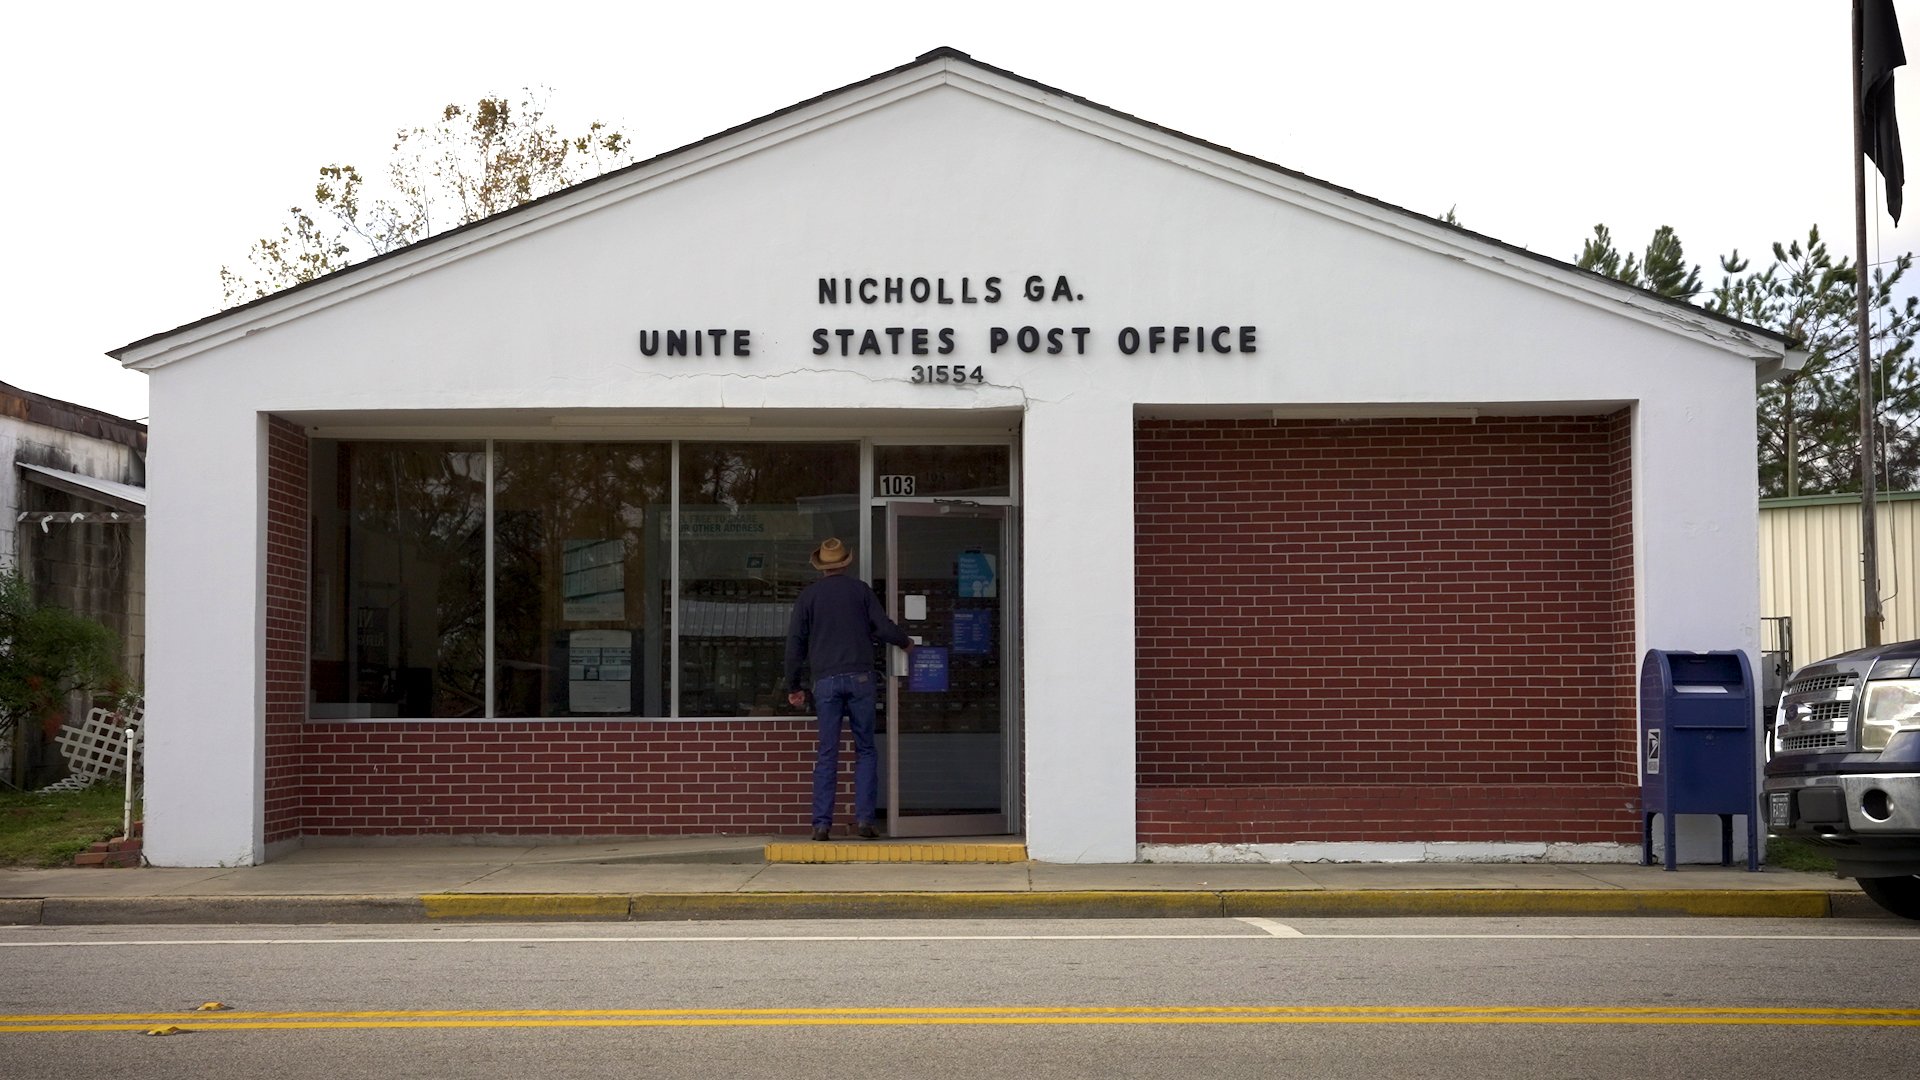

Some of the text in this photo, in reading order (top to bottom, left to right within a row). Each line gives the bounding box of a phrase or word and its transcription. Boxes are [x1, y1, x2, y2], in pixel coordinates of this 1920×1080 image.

[819, 275, 1083, 304] NICHOLLS GA.
[640, 326, 1256, 357] UNITE STATES POST OFFICE
[912, 365, 983, 384] 31554
[883, 476, 913, 494] 103
[692, 524, 721, 532] OTHER
[724, 524, 764, 532] ADDRESS
